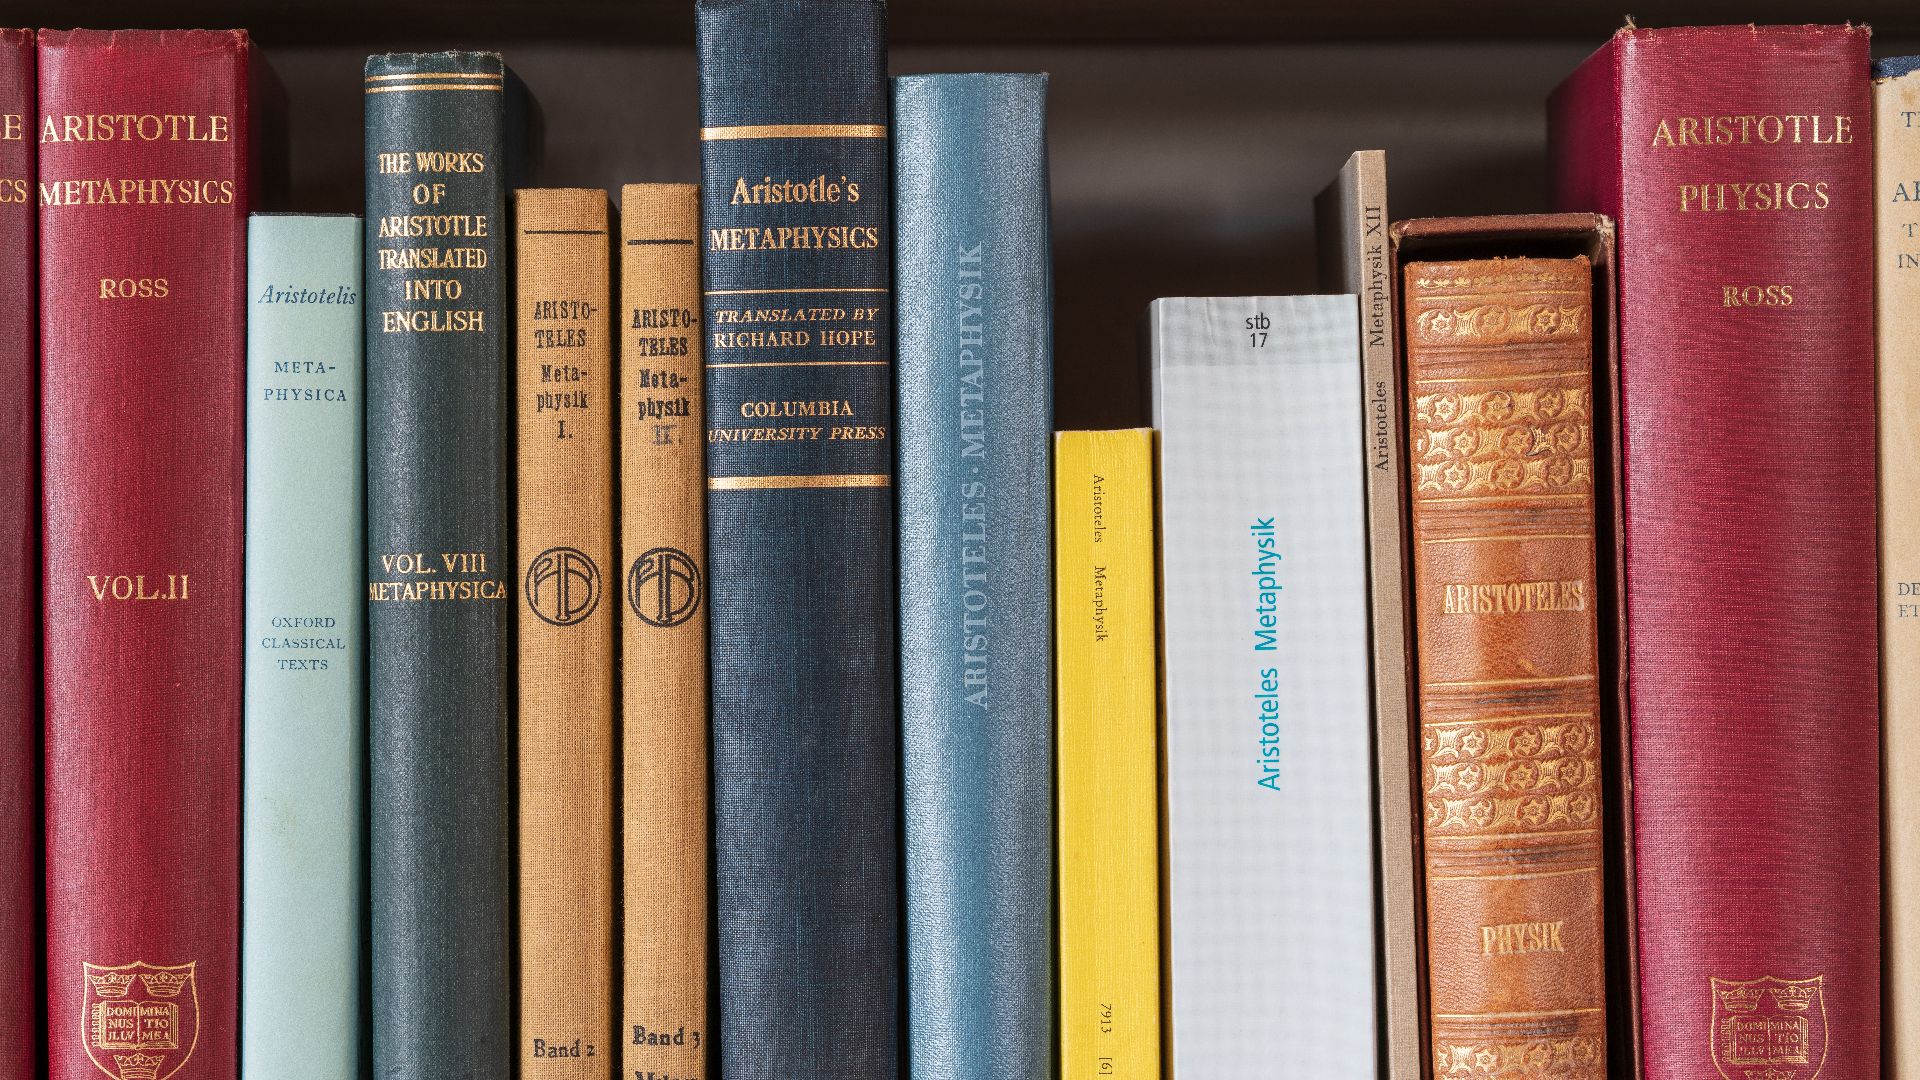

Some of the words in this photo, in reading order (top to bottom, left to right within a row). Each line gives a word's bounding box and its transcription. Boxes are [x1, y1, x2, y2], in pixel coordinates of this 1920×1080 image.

[41, 114, 229, 142] ARISTOTLE
[1652, 115, 1854, 148] ARISTOTLE
[378, 152, 411, 174] THE
[416, 152, 485, 174] WORKS
[39, 179, 234, 206] METAPHYSICS
[413, 184, 445, 205] OF
[730, 174, 860, 206] Aristotle's
[1678, 182, 1830, 212] PHYSICS
[378, 215, 487, 237] ARISTOTLE
[1365, 205, 1382, 237] XII
[710, 226, 879, 254] METAPHYSICS
[378, 248, 487, 270] TRANSLATED
[99, 277, 169, 299] ROSS
[257, 284, 357, 305] Aristotelis
[404, 280, 462, 301] INTO
[1368, 244, 1388, 348] Metaphysik
[1722, 285, 1794, 308] ROSS
[382, 310, 484, 333] ENGLISH
[534, 300, 598, 321] ARISTO-
[632, 308, 698, 330] ARISTO-
[715, 307, 847, 324] TRANSLATED
[853, 307, 880, 322] BY
[1245, 312, 1270, 331] stb
[535, 329, 586, 349] TELES
[639, 337, 688, 358] TELES
[713, 331, 810, 349] RICHARD
[820, 330, 876, 347] HOPE
[955, 240, 986, 460] METAPHYSIK
[1249, 333, 1268, 348] 17
[274, 361, 335, 374] META-
[541, 365, 588, 384] Meta-
[639, 369, 688, 389] Meta-
[264, 388, 347, 401] PHYSICA
[536, 391, 589, 412] physik
[638, 397, 691, 421] physik
[741, 400, 854, 418] COLUMBIA
[708, 427, 821, 443] UNIVERSITY
[830, 425, 886, 441] PRESS
[1373, 381, 1389, 473] Aristoteles
[1092, 473, 1104, 544] Aristoteles
[382, 553, 437, 573] VOL.
[442, 553, 487, 573] VIII
[368, 581, 508, 601] METAPHYSICA
[1250, 517, 1283, 651] Metaphysik
[960, 482, 989, 710] ARISTOTELES
[1093, 566, 1108, 643] Metaphysik
[1443, 580, 1585, 615] ARISTOTELES
[271, 617, 335, 629] OXFORD
[261, 637, 346, 650] CLASSICAL
[277, 659, 329, 671] TEXTS
[1256, 667, 1282, 791] Aristoteles
[1480, 920, 1565, 957] PHYSIK
[106, 1006, 137, 1017] DOMI
[141, 1006, 170, 1017] MINA
[1100, 1003, 1112, 1034] 7913
[108, 1018, 134, 1029] NUS
[144, 1018, 169, 1029] TIO
[632, 1025, 684, 1046] Band
[692, 1031, 700, 1048] 3
[533, 1039, 581, 1058] Band
[586, 1045, 595, 1056] 2
[1098, 1057, 1113, 1075] [6]
